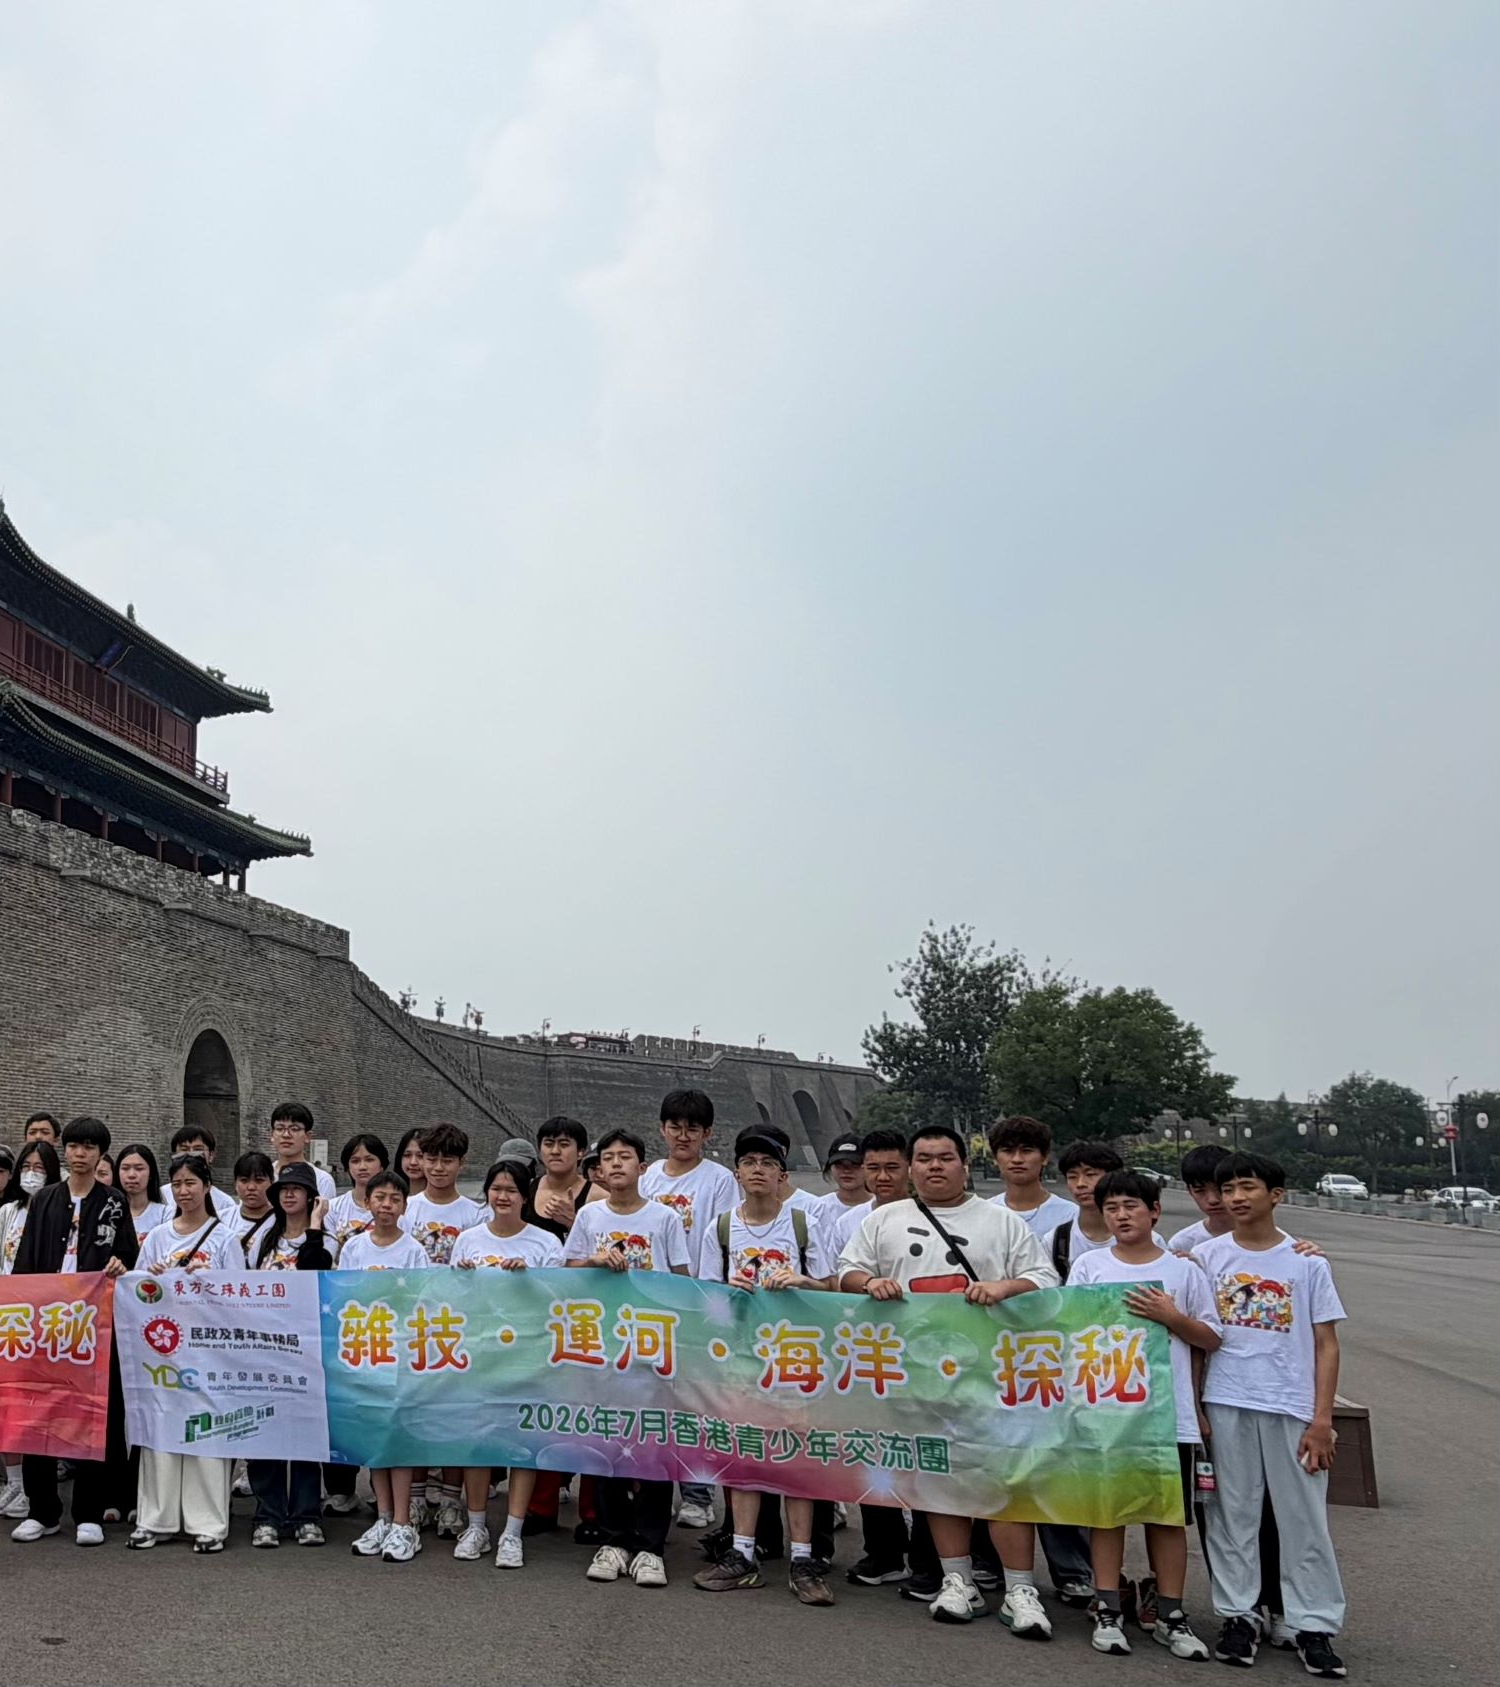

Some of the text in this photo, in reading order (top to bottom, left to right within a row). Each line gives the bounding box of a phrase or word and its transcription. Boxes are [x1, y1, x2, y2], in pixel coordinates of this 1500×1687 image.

[174, 1280, 286, 1298] 東方之珠義工團
[191, 1327, 300, 1348] 民政及青年事務局
[212, 1342, 226, 1350] and
[228, 1342, 251, 1350] Youth
[252, 1343, 276, 1351] Affairs
[207, 1371, 308, 1386] 青年發展委員會
[518, 1402, 951, 1476] 2026年7月香港青少年交流團
